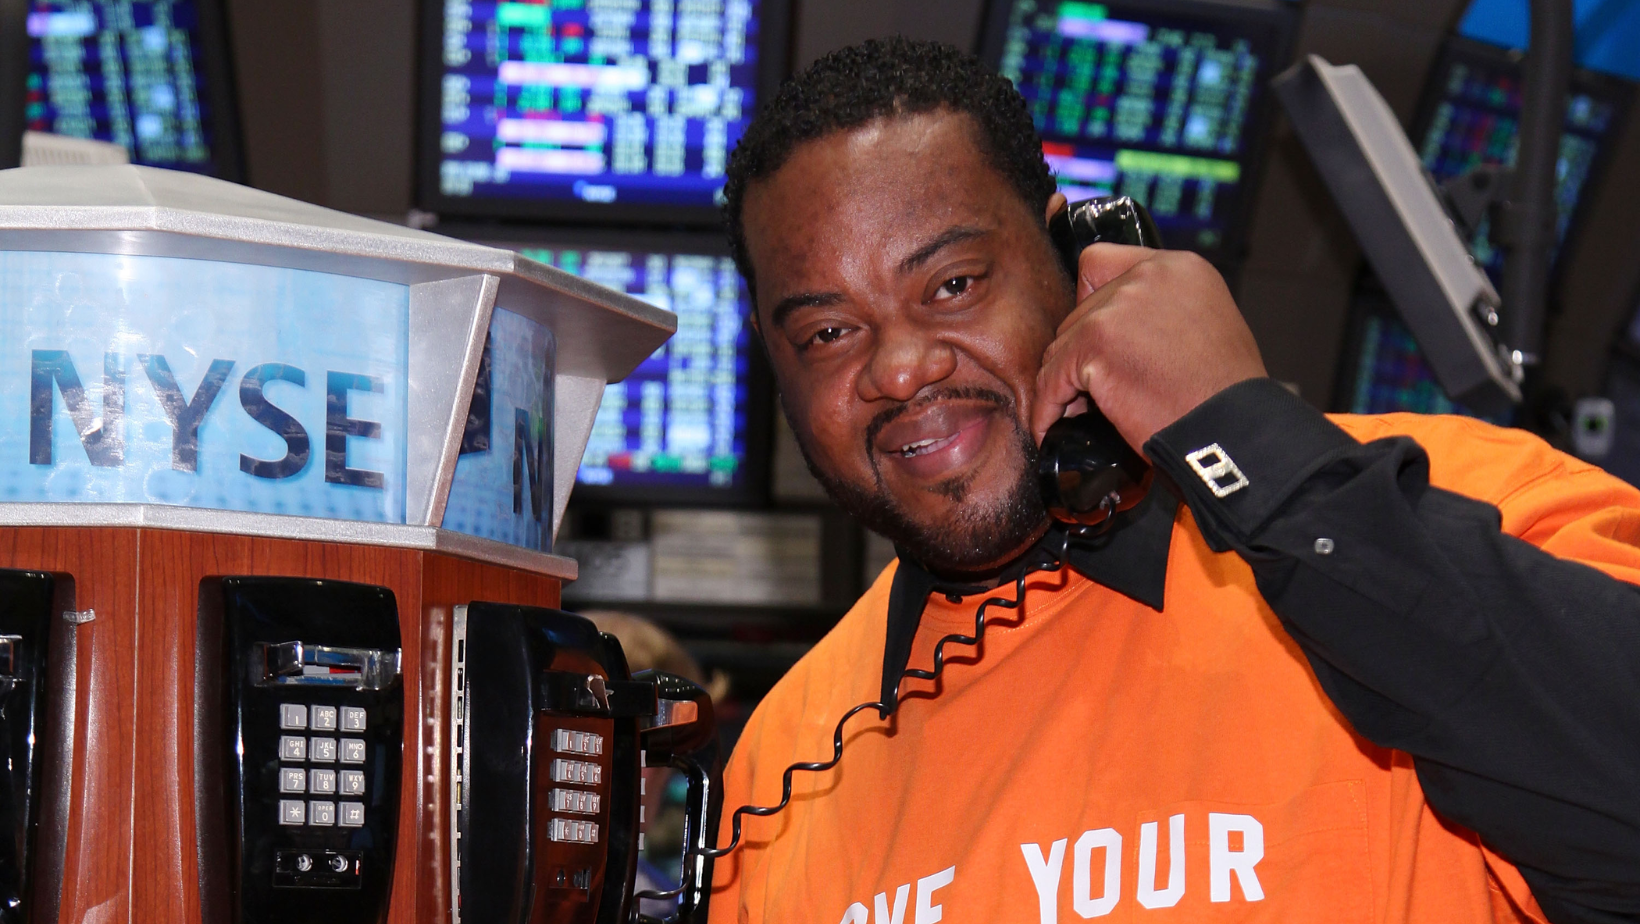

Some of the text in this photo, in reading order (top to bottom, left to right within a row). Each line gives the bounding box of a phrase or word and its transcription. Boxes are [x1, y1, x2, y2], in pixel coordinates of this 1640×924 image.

[28, 348, 386, 490] NYSE
[320, 710, 334, 718] ABC
[350, 711, 364, 719] DEF
[324, 718, 330, 727] 2
[354, 718, 360, 728] 3
[293, 748, 300, 756] 4
[323, 748, 330, 758] 5
[352, 750, 359, 758] 6
[292, 780, 299, 788] 7
[322, 780, 329, 790] 8
[352, 782, 358, 790] 9
[322, 812, 328, 821] 0
[1020, 812, 1265, 924] YOUR
